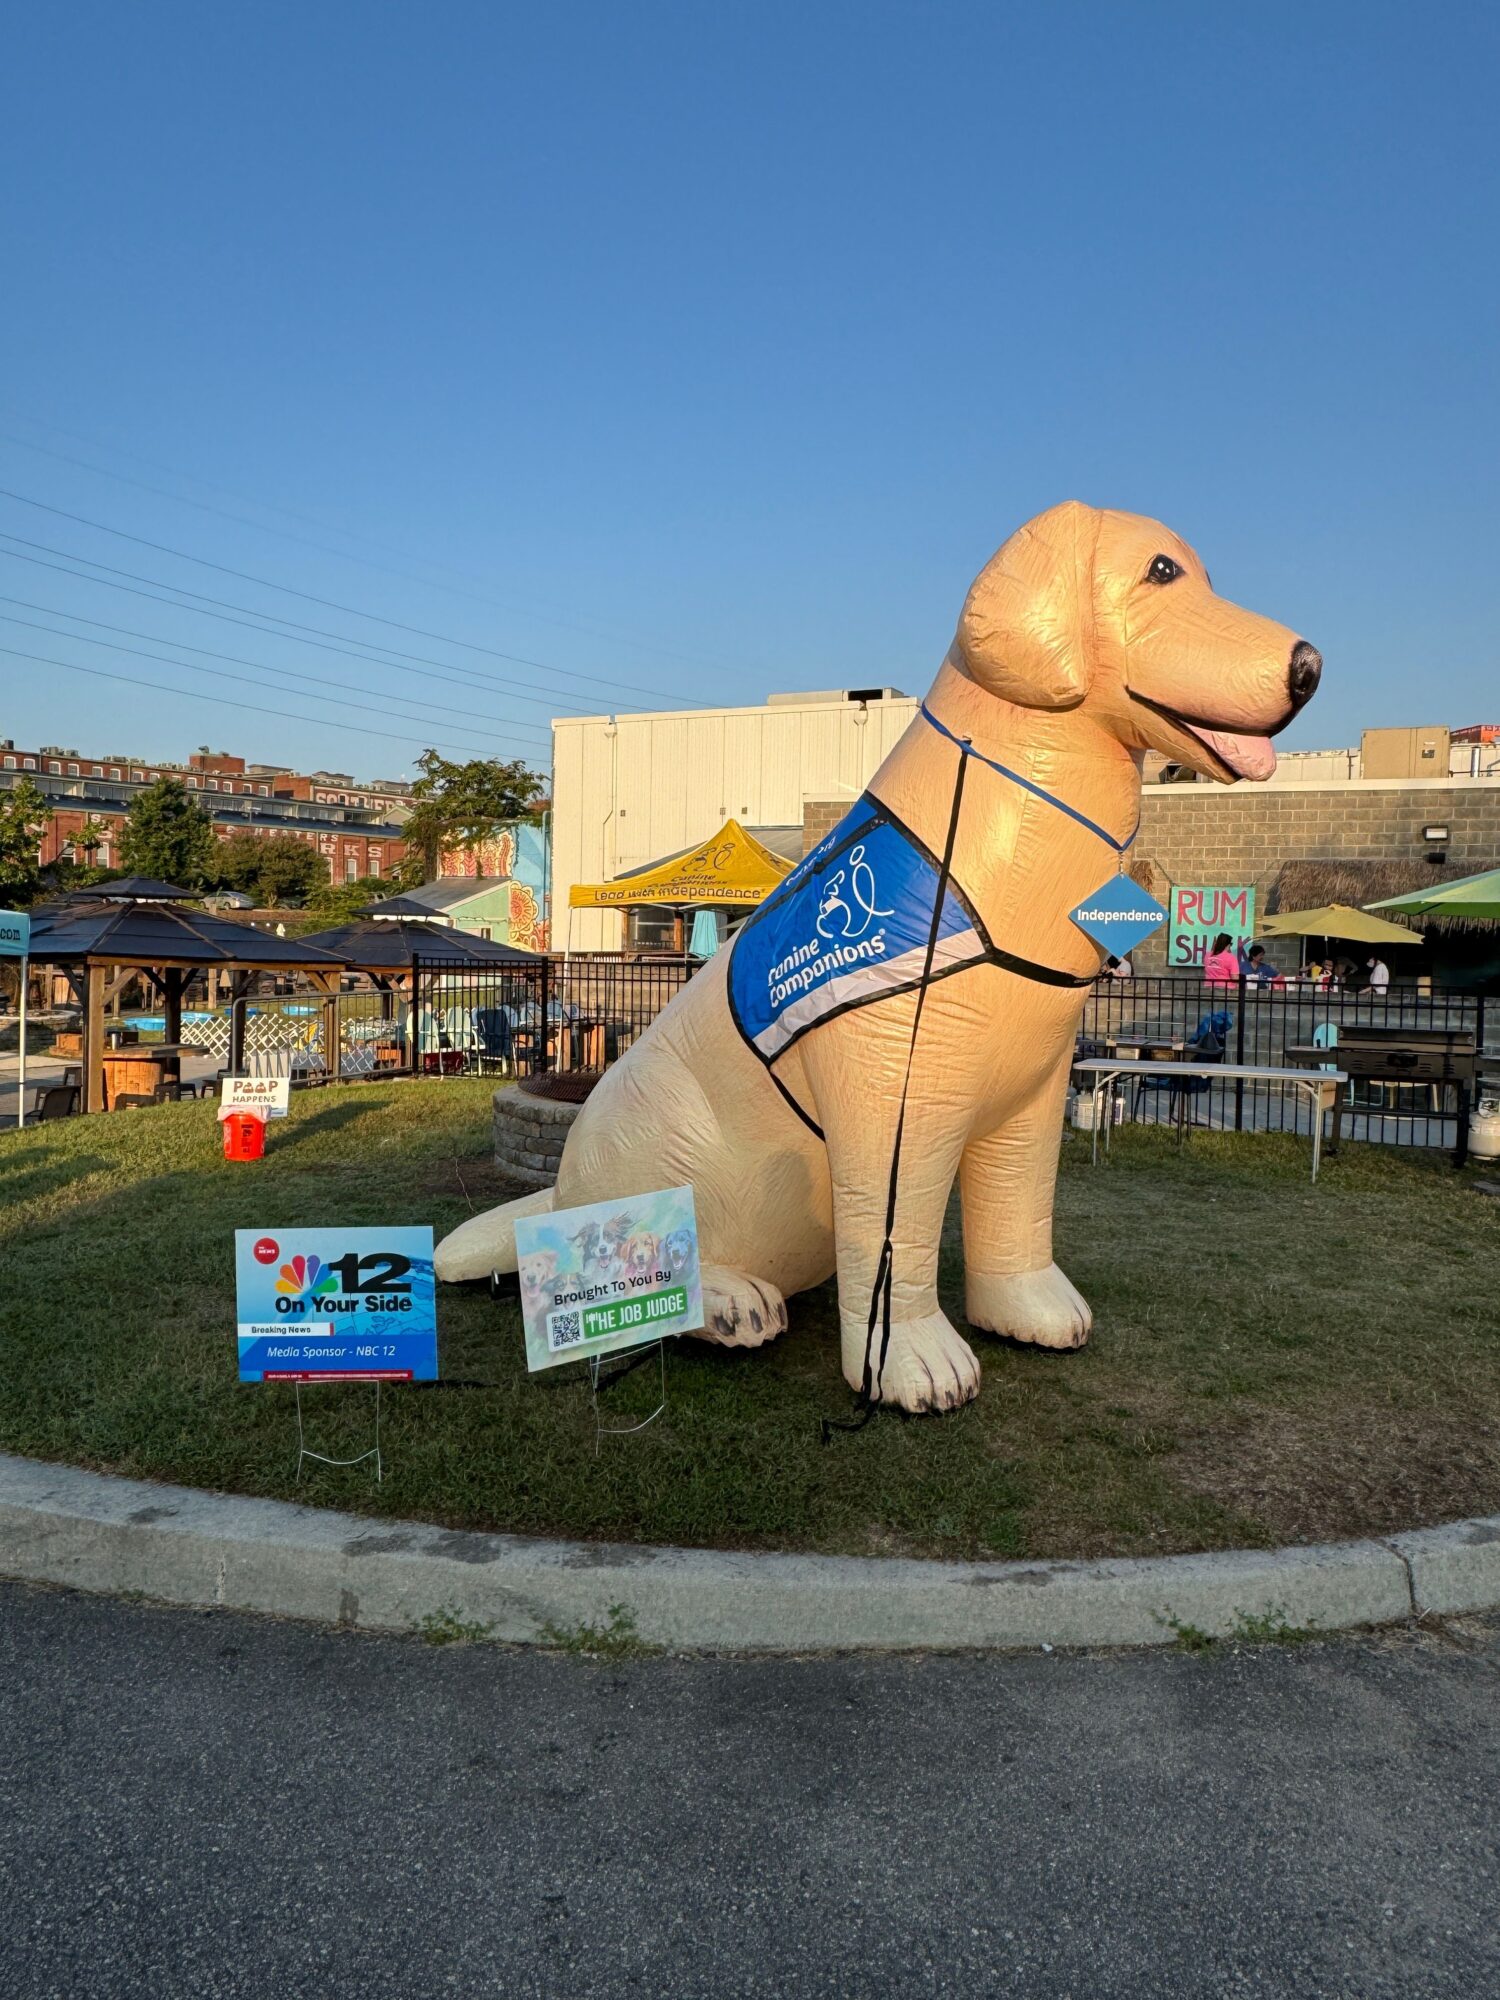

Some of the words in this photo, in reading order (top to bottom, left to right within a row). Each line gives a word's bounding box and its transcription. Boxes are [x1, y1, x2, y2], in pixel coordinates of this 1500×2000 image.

[1077, 909, 1164, 924] Independence
[1176, 889, 1248, 927] RUM
[1175, 934, 1251, 964] SHK
[770, 934, 886, 1008] companions
[232, 1095, 277, 1103] HAPPENS
[328, 1252, 412, 1294] 12
[554, 1285, 608, 1306] Brought
[611, 1281, 626, 1293] To
[628, 1274, 652, 1288] You
[655, 1270, 672, 1282] By
[275, 1296, 305, 1313] On
[311, 1296, 359, 1313] Your
[364, 1295, 413, 1313] Side
[586, 1309, 616, 1333] THE
[619, 1303, 642, 1326] JOB
[645, 1293, 685, 1319] JUDGE
[251, 1326, 287, 1335] Breaking
[288, 1326, 311, 1334] News
[267, 1346, 300, 1358] Media
[302, 1346, 346, 1359] Sponsor
[356, 1346, 379, 1357] NBC
[382, 1345, 396, 1356] 12
